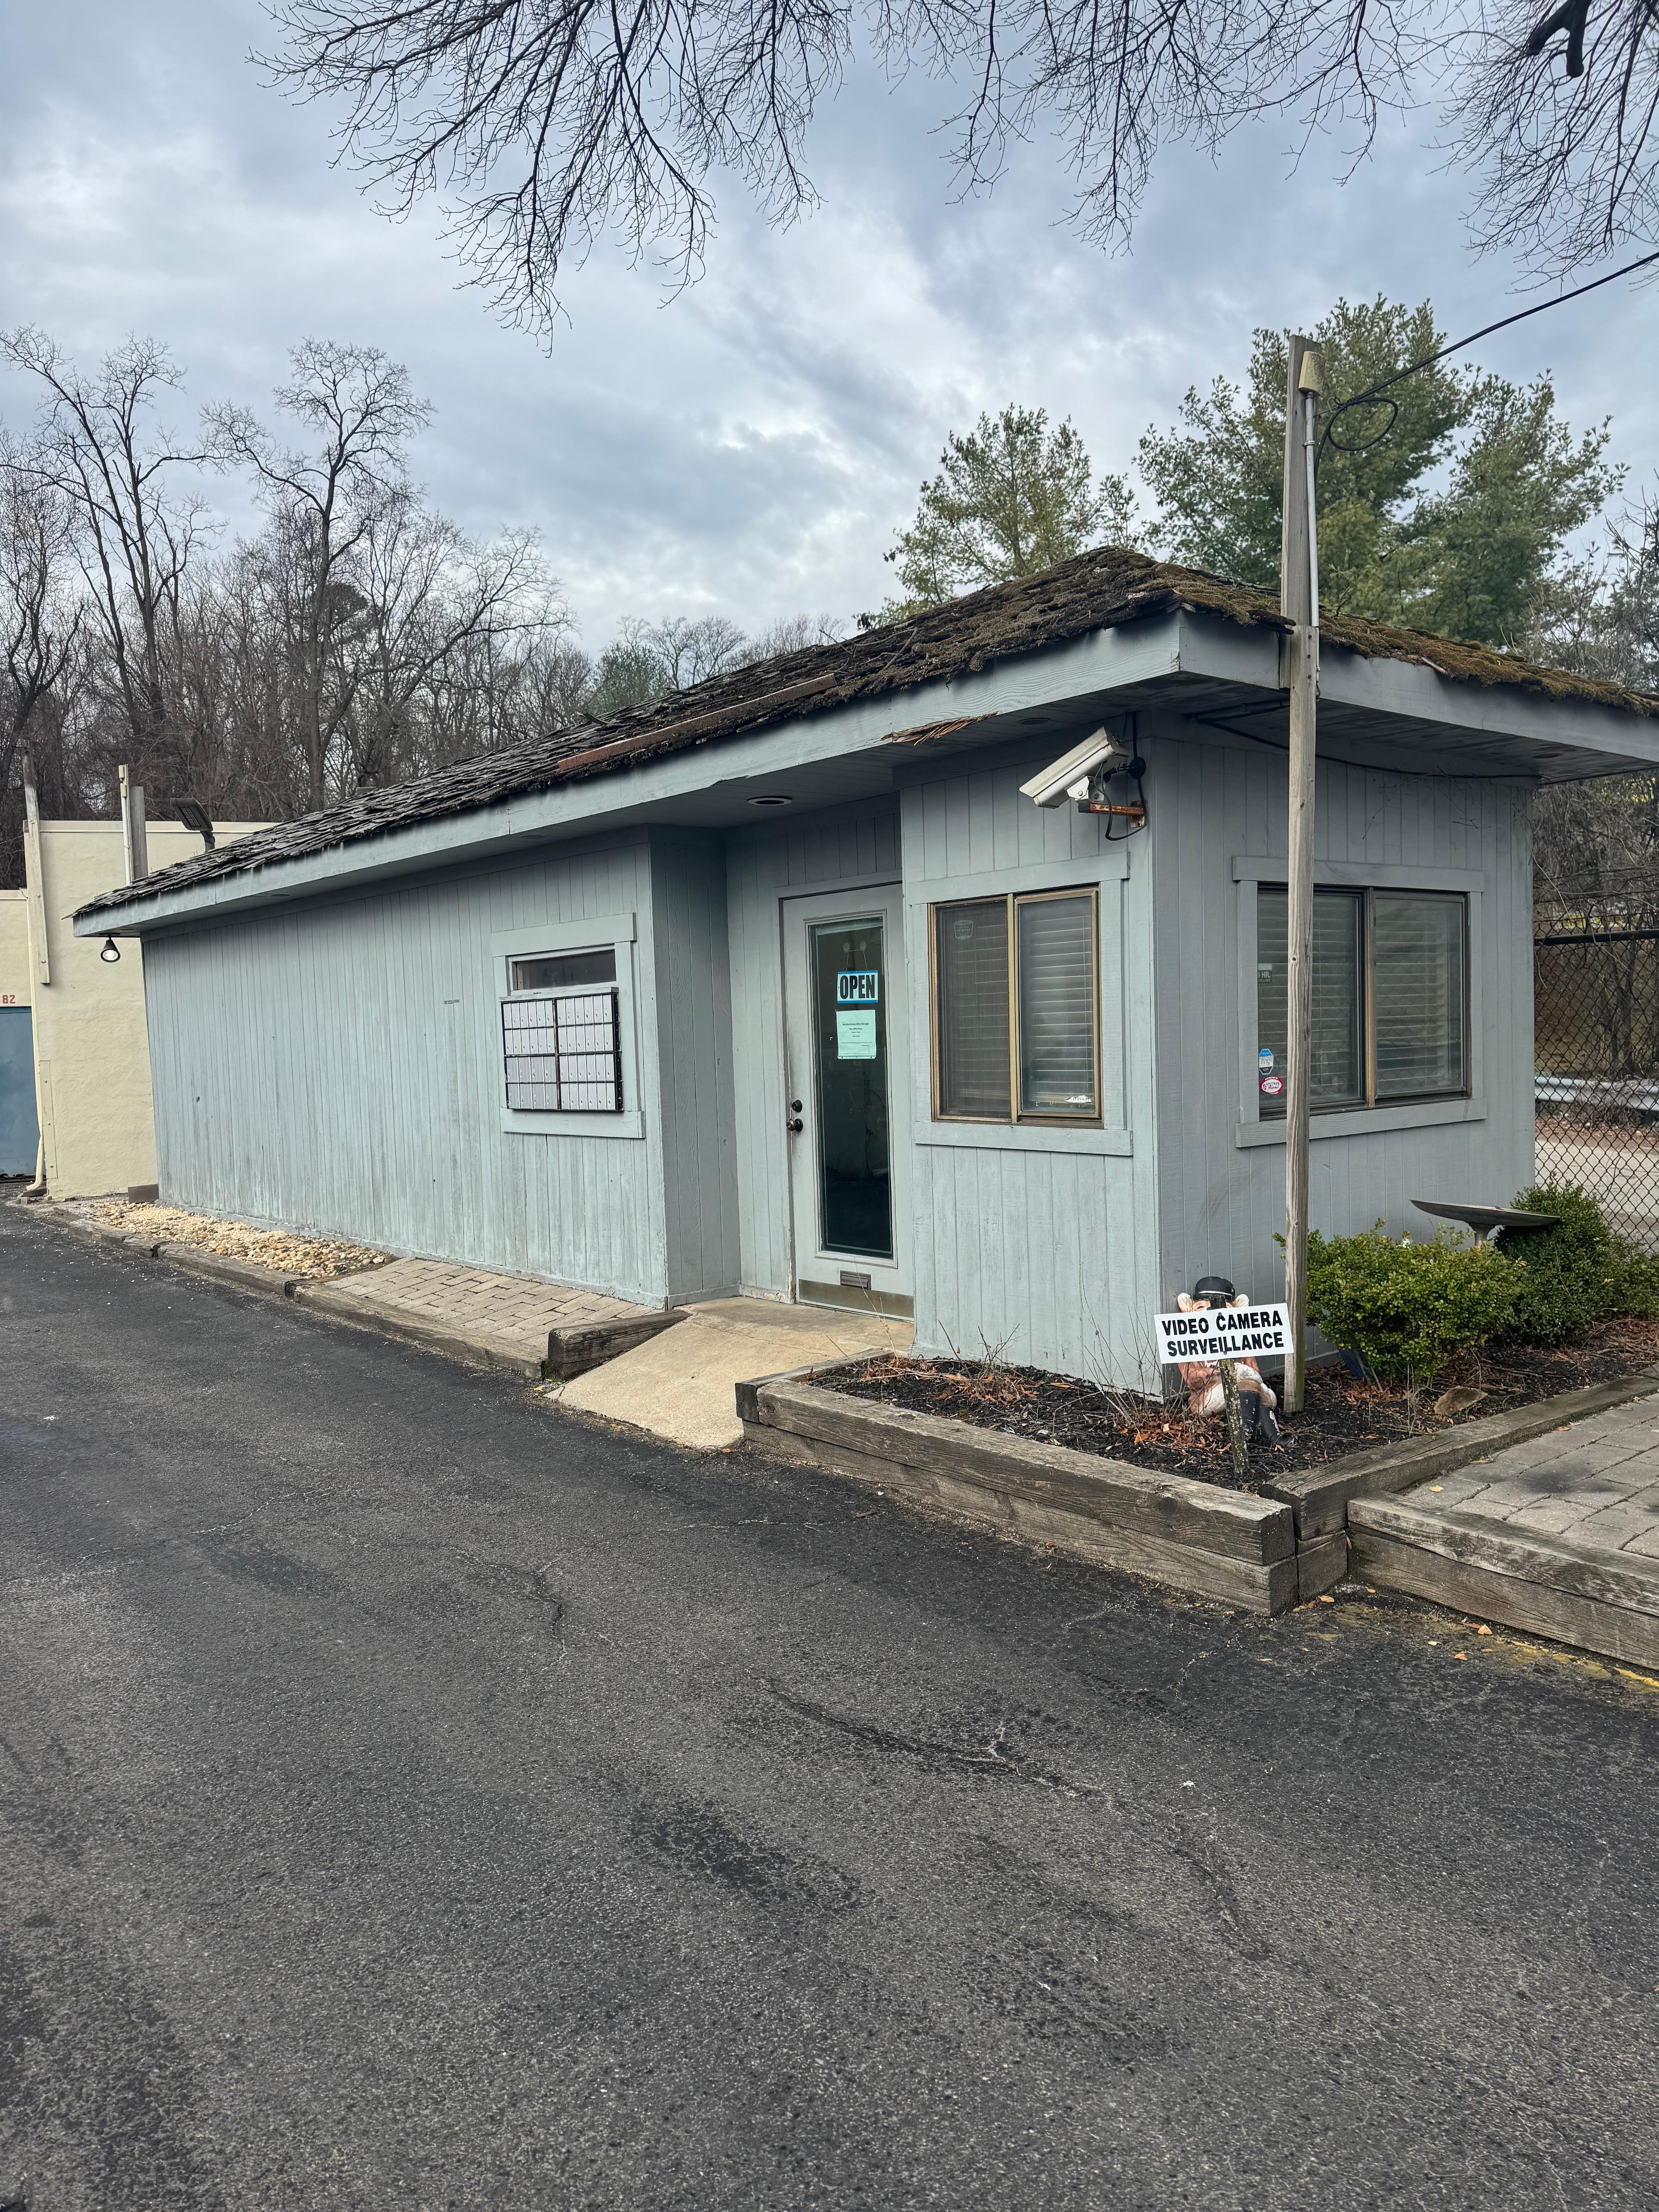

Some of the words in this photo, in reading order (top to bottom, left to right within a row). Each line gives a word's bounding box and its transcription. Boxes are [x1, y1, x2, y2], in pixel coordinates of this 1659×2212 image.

[840, 975, 875, 1000] OPEN
[1162, 1317, 1209, 1336] VIDEO
[1216, 1310, 1283, 1331] CAMERA
[1167, 1332, 1284, 1357] SURVEILLANCE
